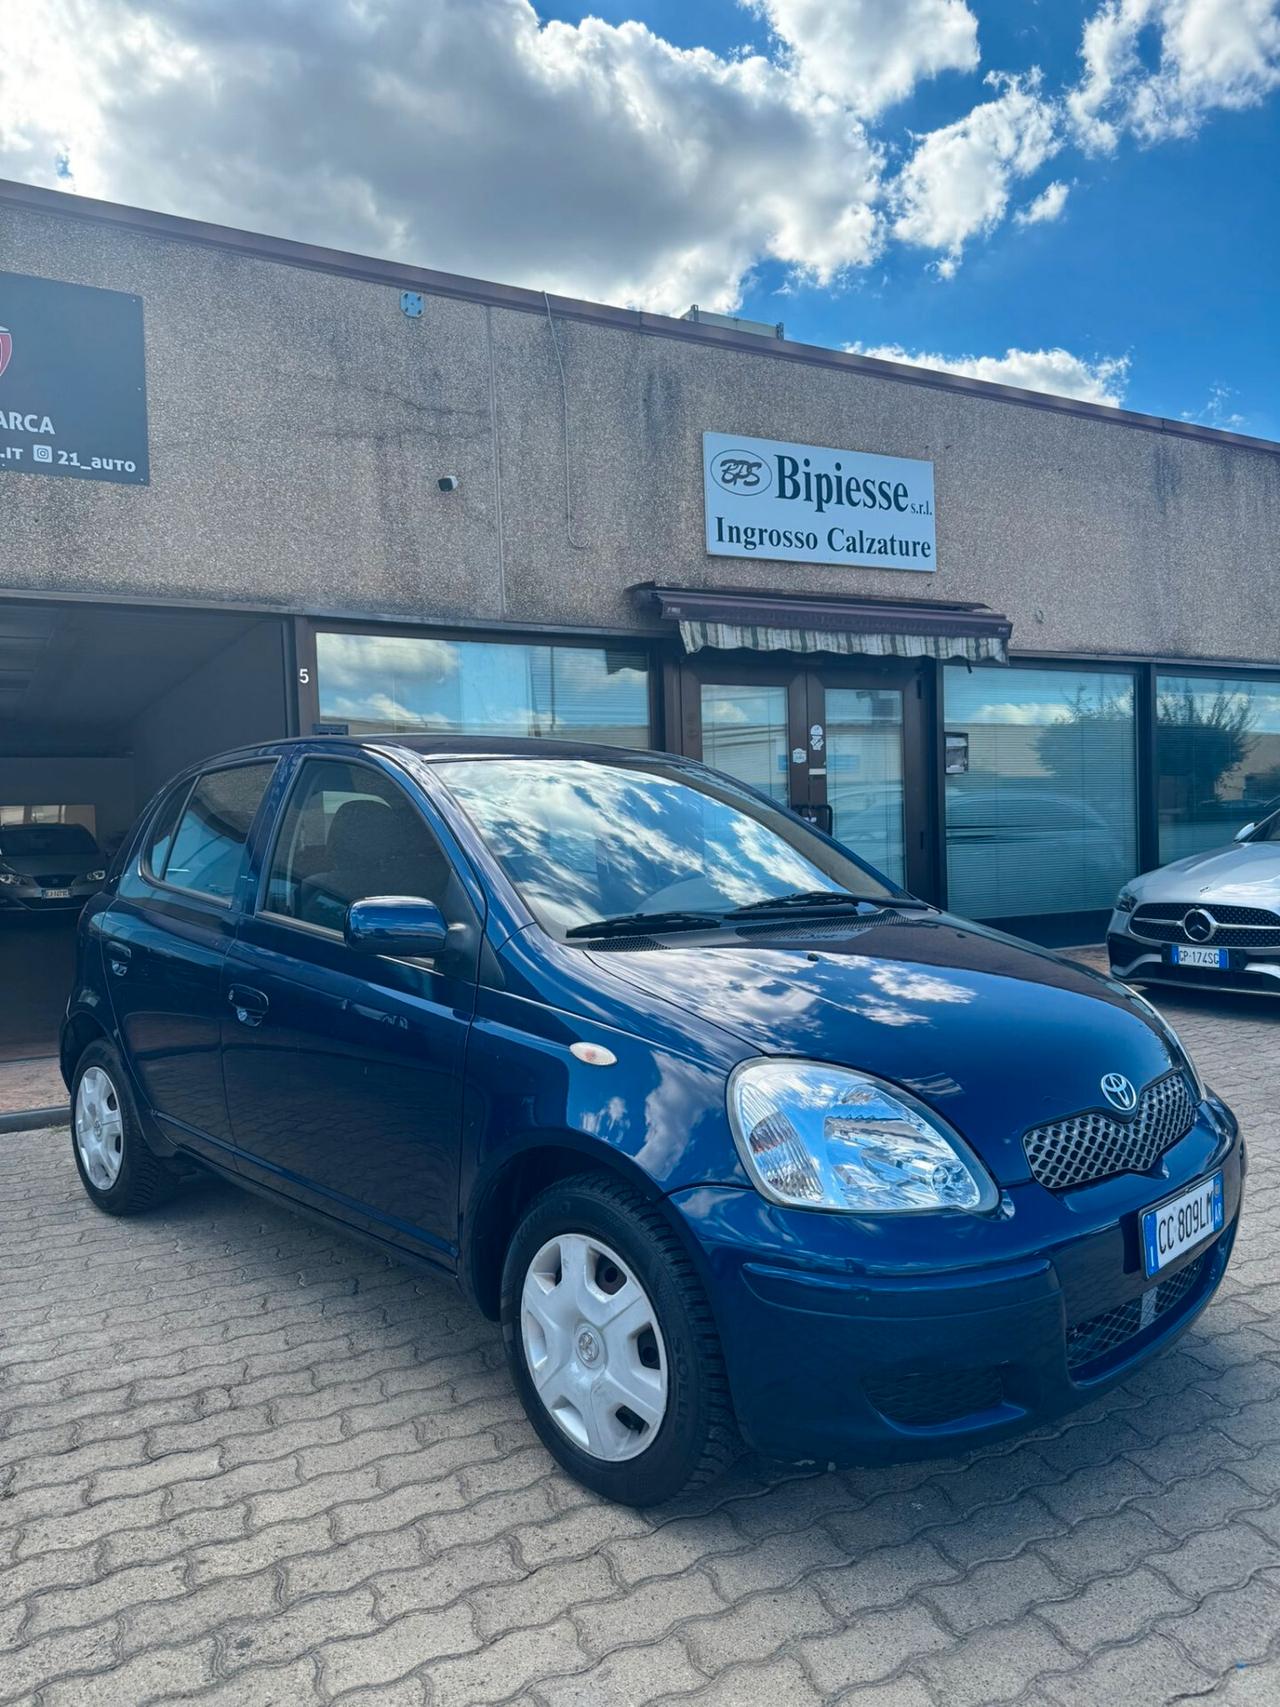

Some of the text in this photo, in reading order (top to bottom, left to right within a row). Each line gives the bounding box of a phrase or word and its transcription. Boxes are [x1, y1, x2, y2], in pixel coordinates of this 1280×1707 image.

[773, 454, 933, 516] Bipiesse s.r.l.
[715, 516, 932, 558] Ingrosso Calzature
[299, 668, 309, 684] 5
